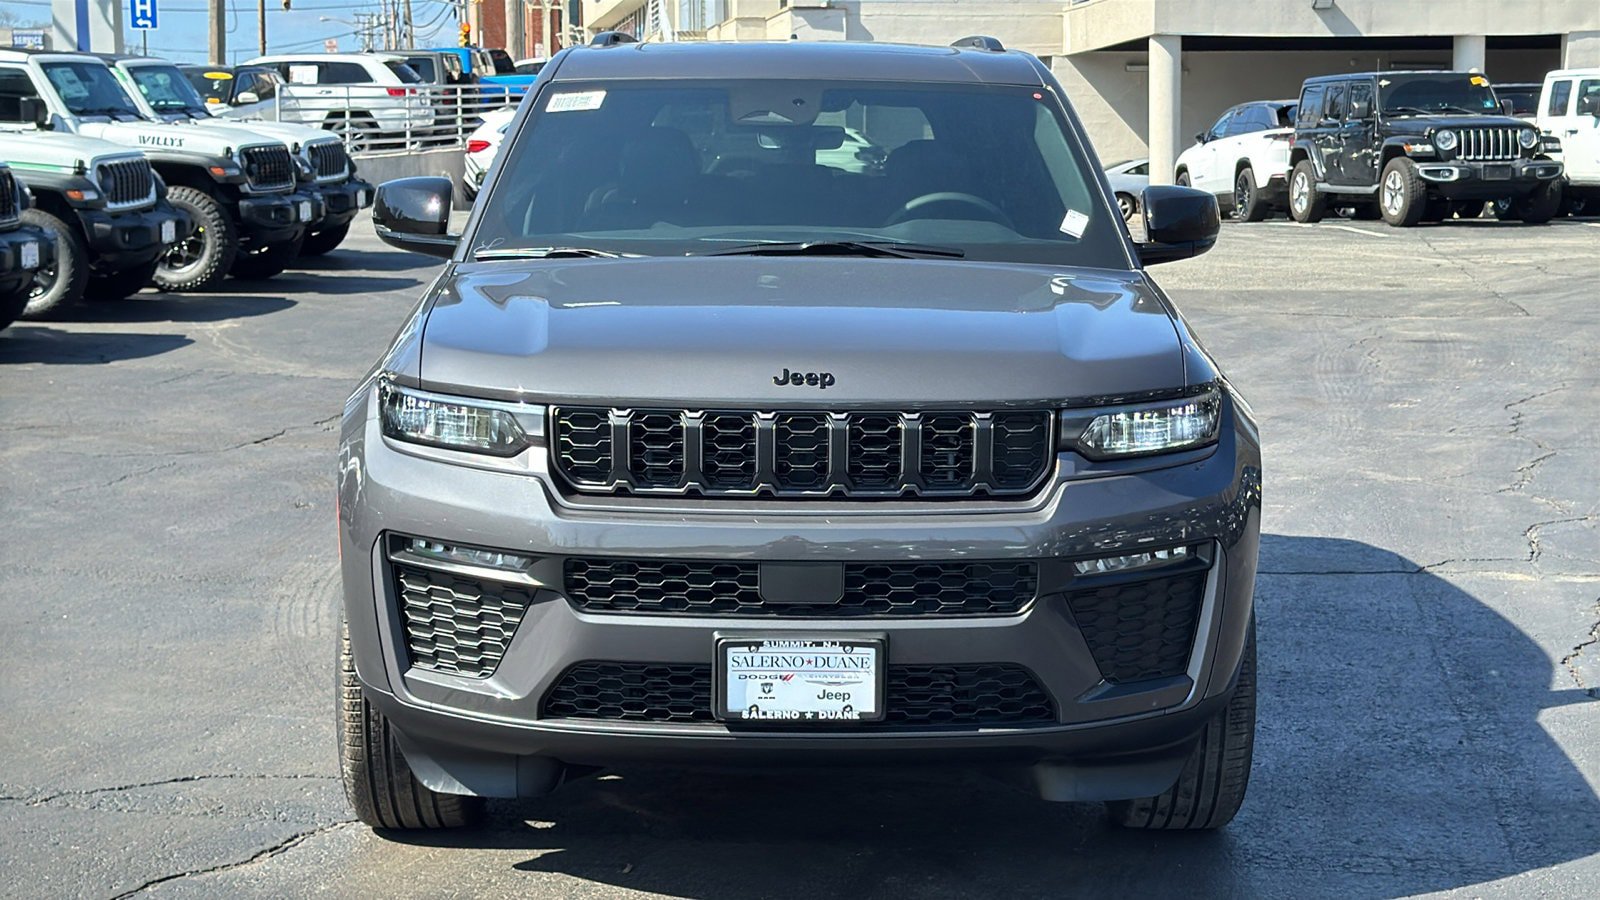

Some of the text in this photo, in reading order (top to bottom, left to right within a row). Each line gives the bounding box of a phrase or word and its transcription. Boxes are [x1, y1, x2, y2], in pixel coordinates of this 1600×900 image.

[136, 0, 152, 18] H
[14, 35, 43, 45] SERVICE
[139, 135, 185, 147] WILLYS
[773, 368, 835, 389] Jeep
[823, 640, 840, 648] NJ
[731, 655, 871, 669] SALERNO DUANE
[817, 689, 851, 702] Jeep
[741, 710, 860, 719] SALERNO DUANE
